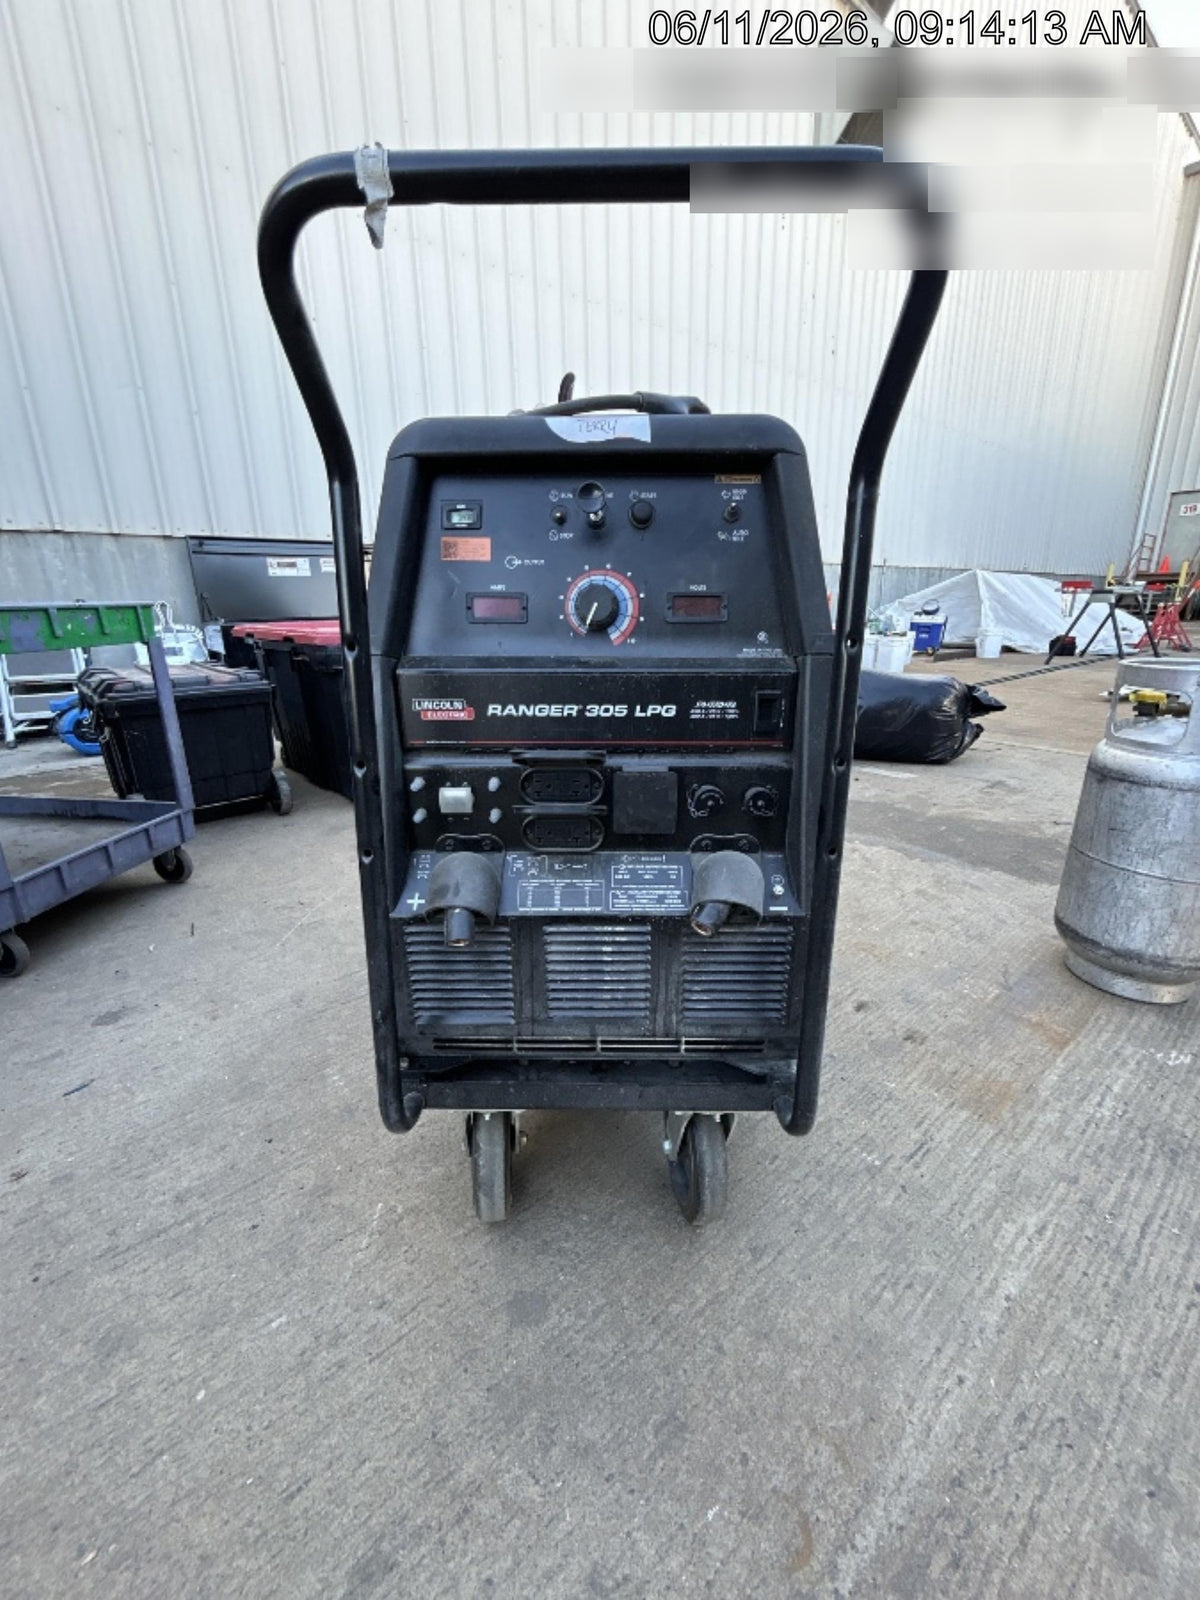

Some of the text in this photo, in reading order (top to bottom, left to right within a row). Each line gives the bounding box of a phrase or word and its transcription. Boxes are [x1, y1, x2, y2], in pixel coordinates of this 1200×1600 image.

[577, 419, 618, 435] TERRY
[415, 701, 463, 710] LINCOLN
[486, 704, 677, 717] RANGER 305 LPG
